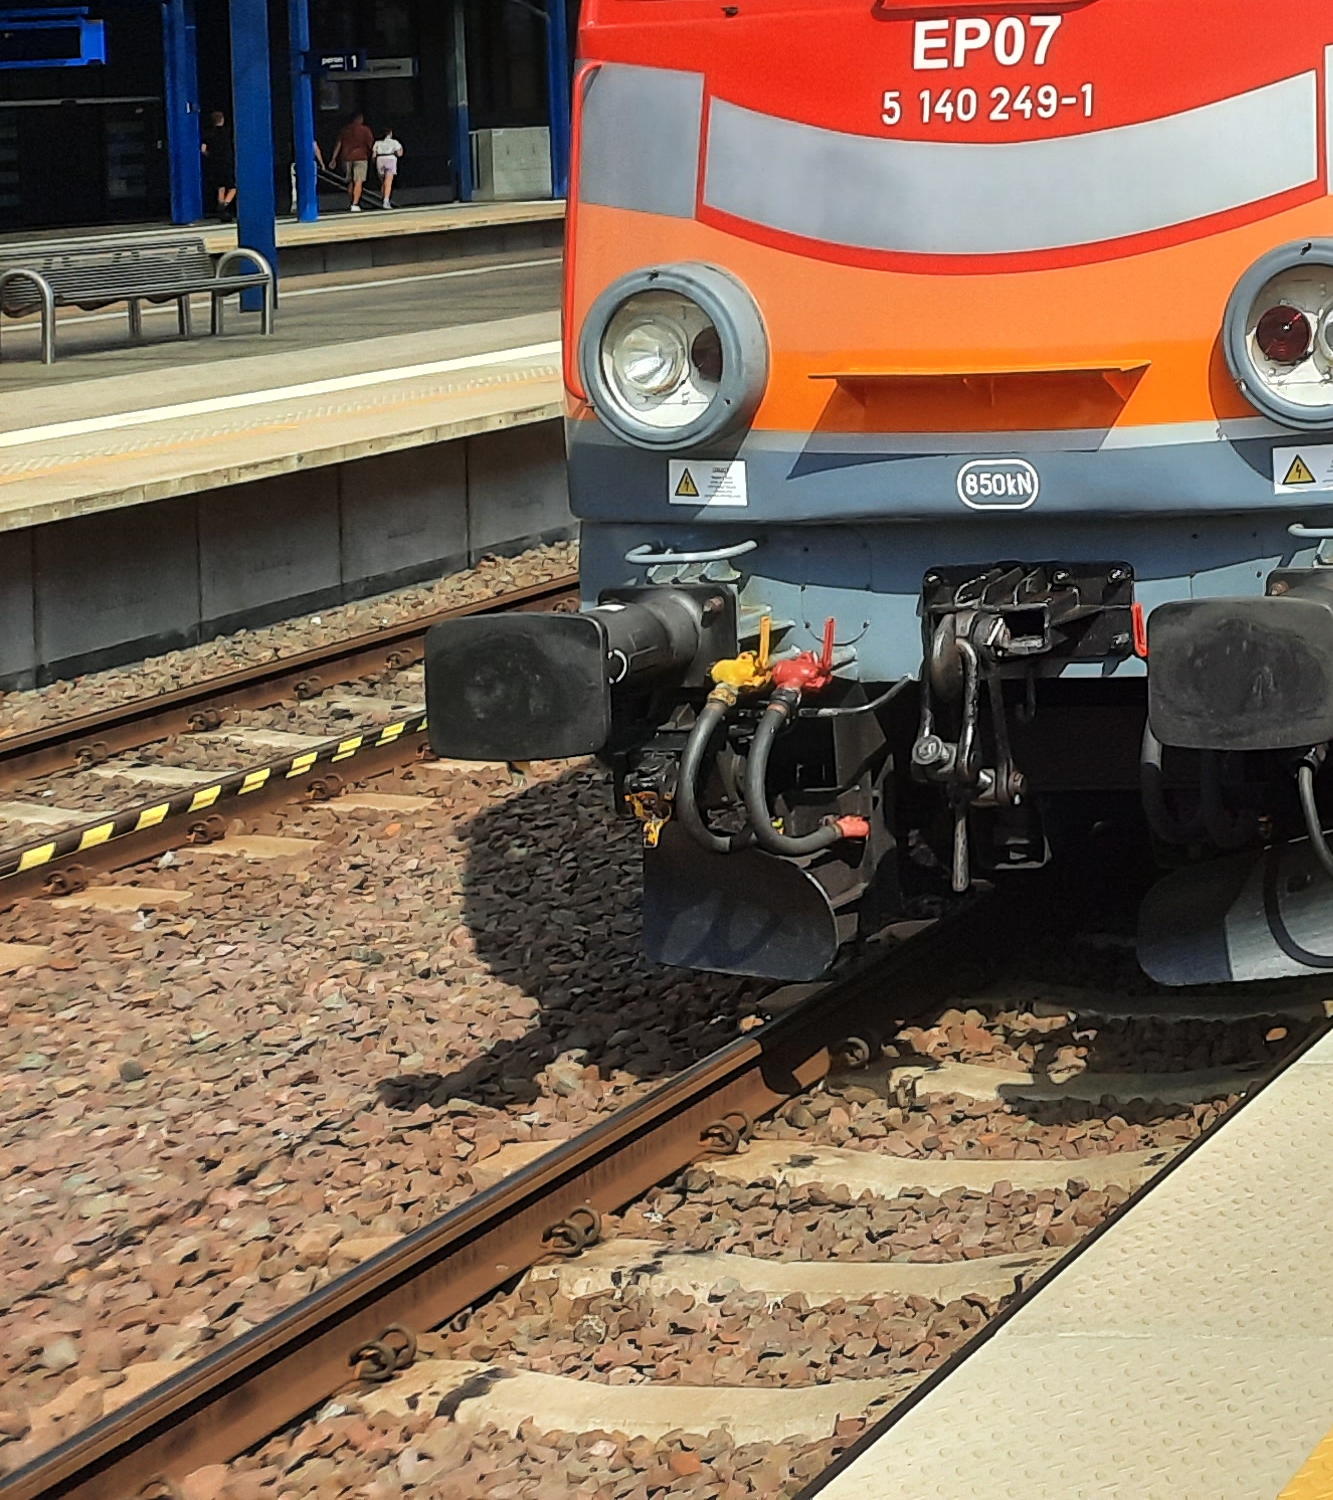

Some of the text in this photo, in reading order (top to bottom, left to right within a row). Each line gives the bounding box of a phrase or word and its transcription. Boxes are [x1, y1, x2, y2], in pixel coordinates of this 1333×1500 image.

[913, 14, 1062, 70] EP07
[350, 55, 357, 69] 1
[881, 83, 1093, 125] 5 140 249-1
[965, 471, 1033, 496] 850kN
